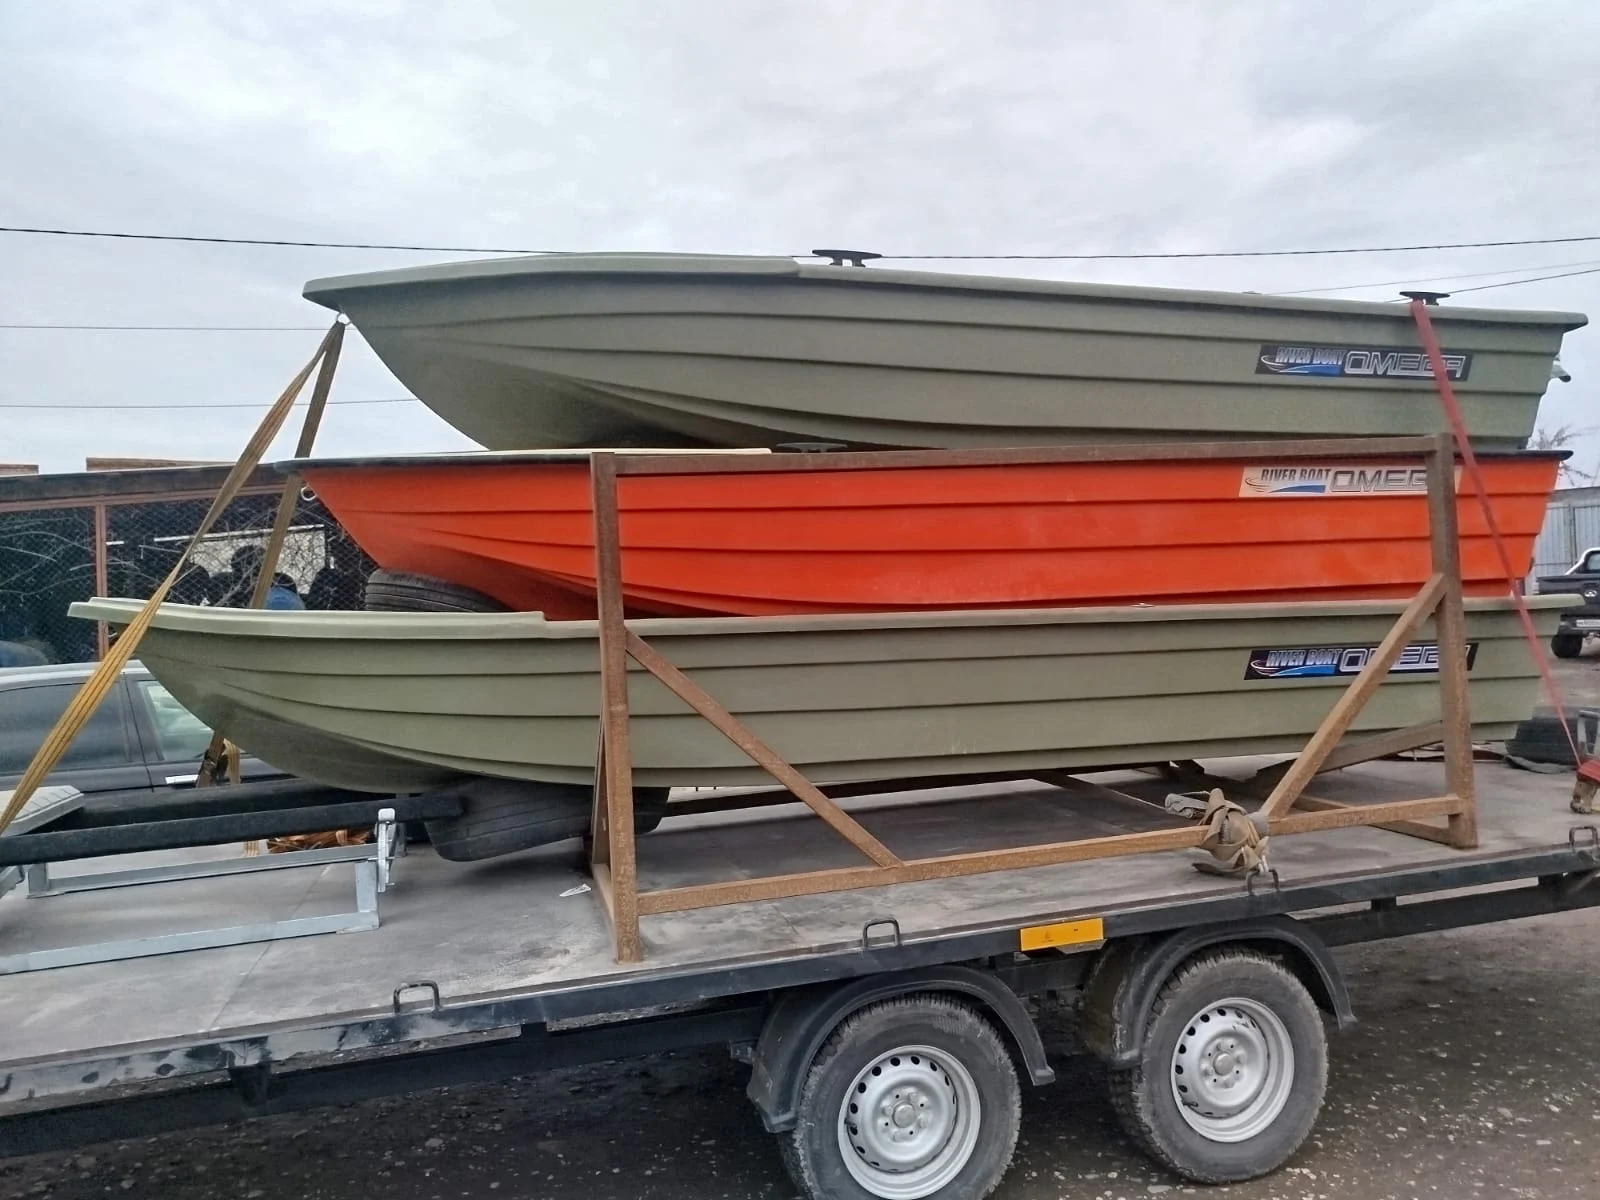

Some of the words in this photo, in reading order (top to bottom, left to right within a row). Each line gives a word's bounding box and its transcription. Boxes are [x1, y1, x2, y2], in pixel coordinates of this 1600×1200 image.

[1275, 347, 1313, 364] RIVER
[1312, 349, 1347, 365] BOAT
[1260, 468, 1296, 481] RIVER
[1299, 468, 1331, 481] BOAT
[1330, 469, 1428, 492] OMEG
[1266, 650, 1307, 667] RIVER
[1305, 648, 1343, 666] BOAT
